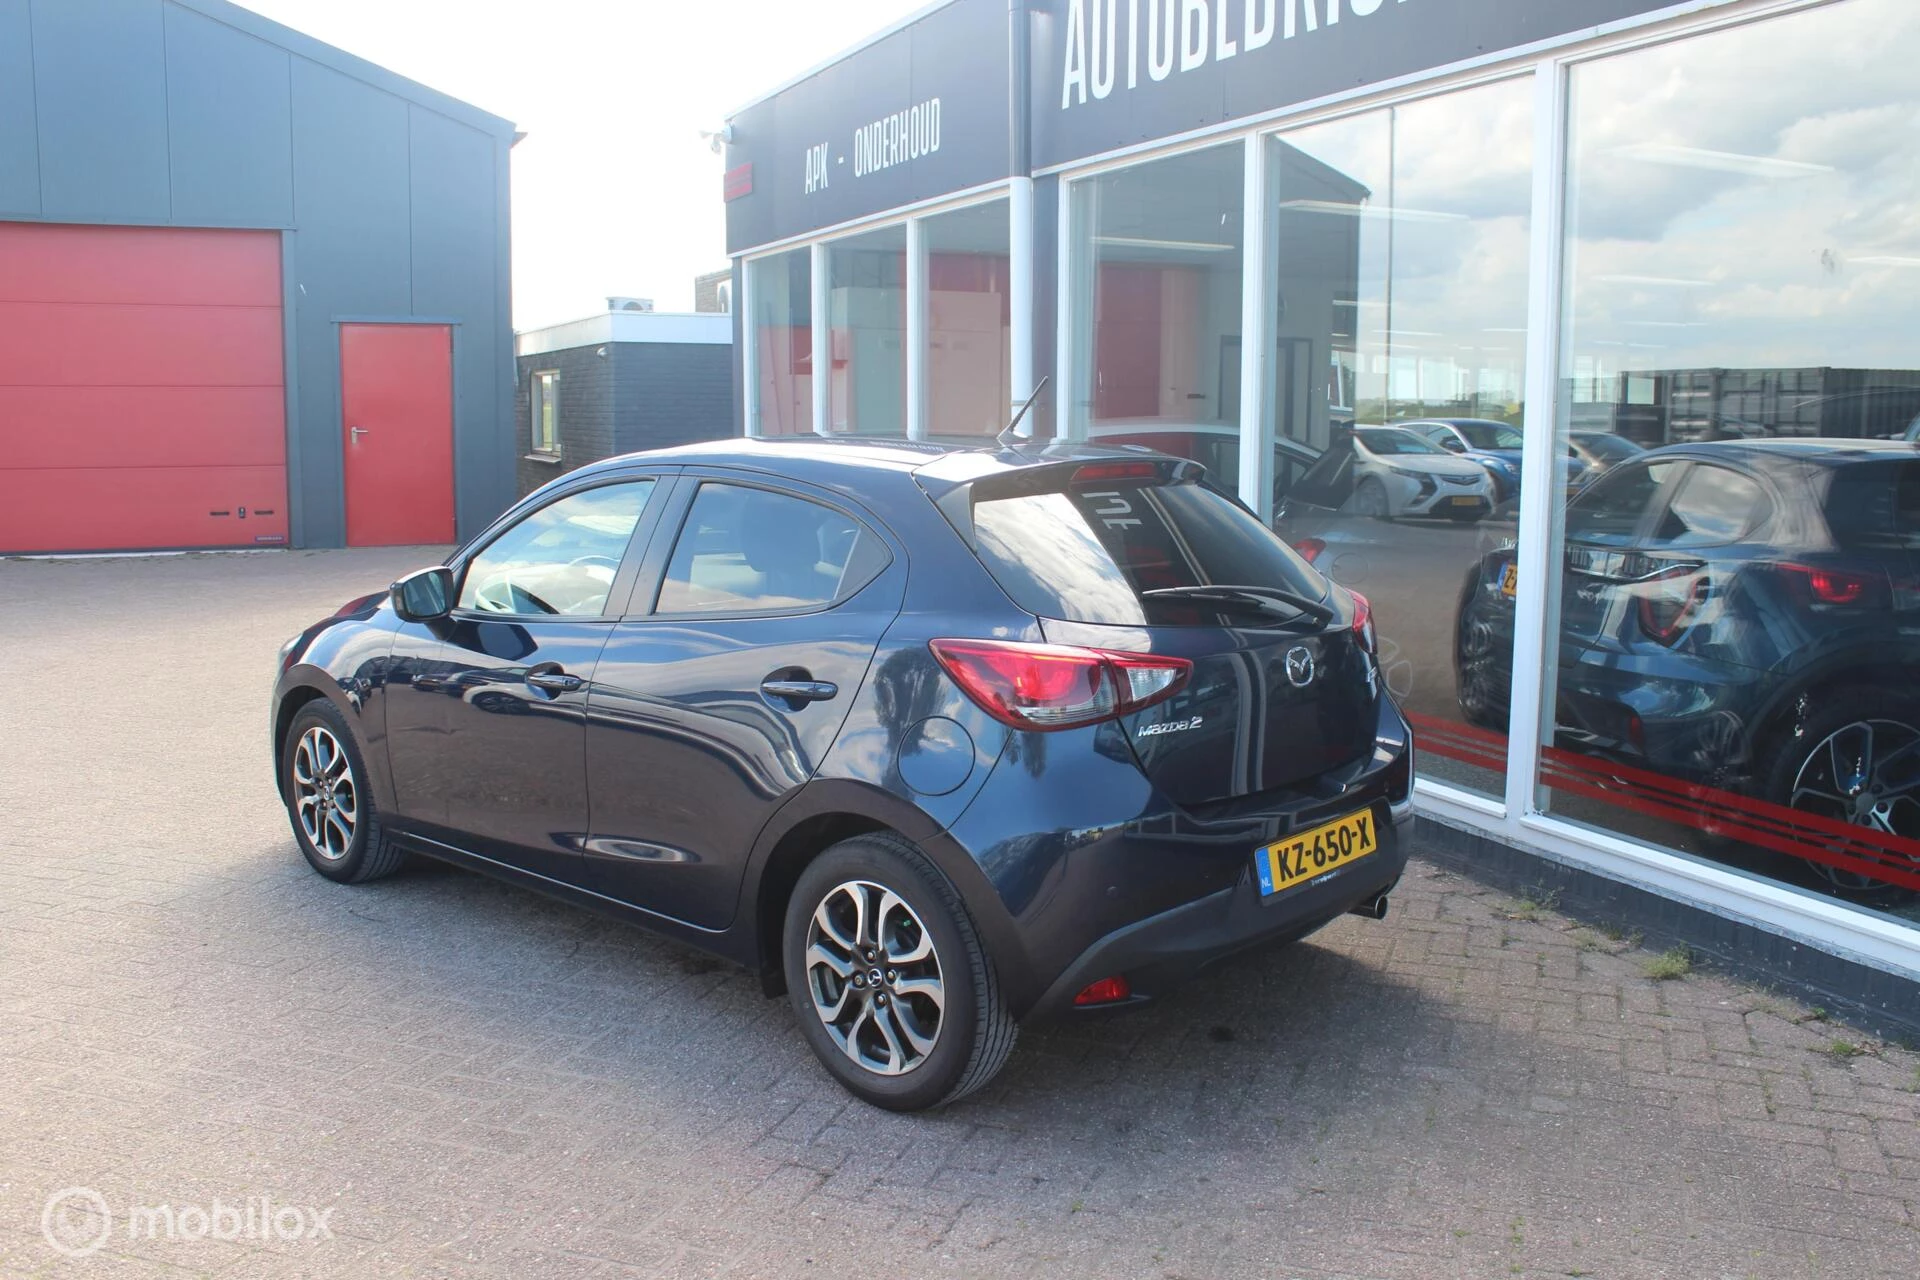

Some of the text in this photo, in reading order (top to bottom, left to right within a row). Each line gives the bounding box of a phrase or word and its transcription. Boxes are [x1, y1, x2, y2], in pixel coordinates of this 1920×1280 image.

[805, 141, 828, 194] APK
[854, 98, 940, 177] ONDERHOUD
[1261, 817, 1371, 889] NL KZ-650-X
